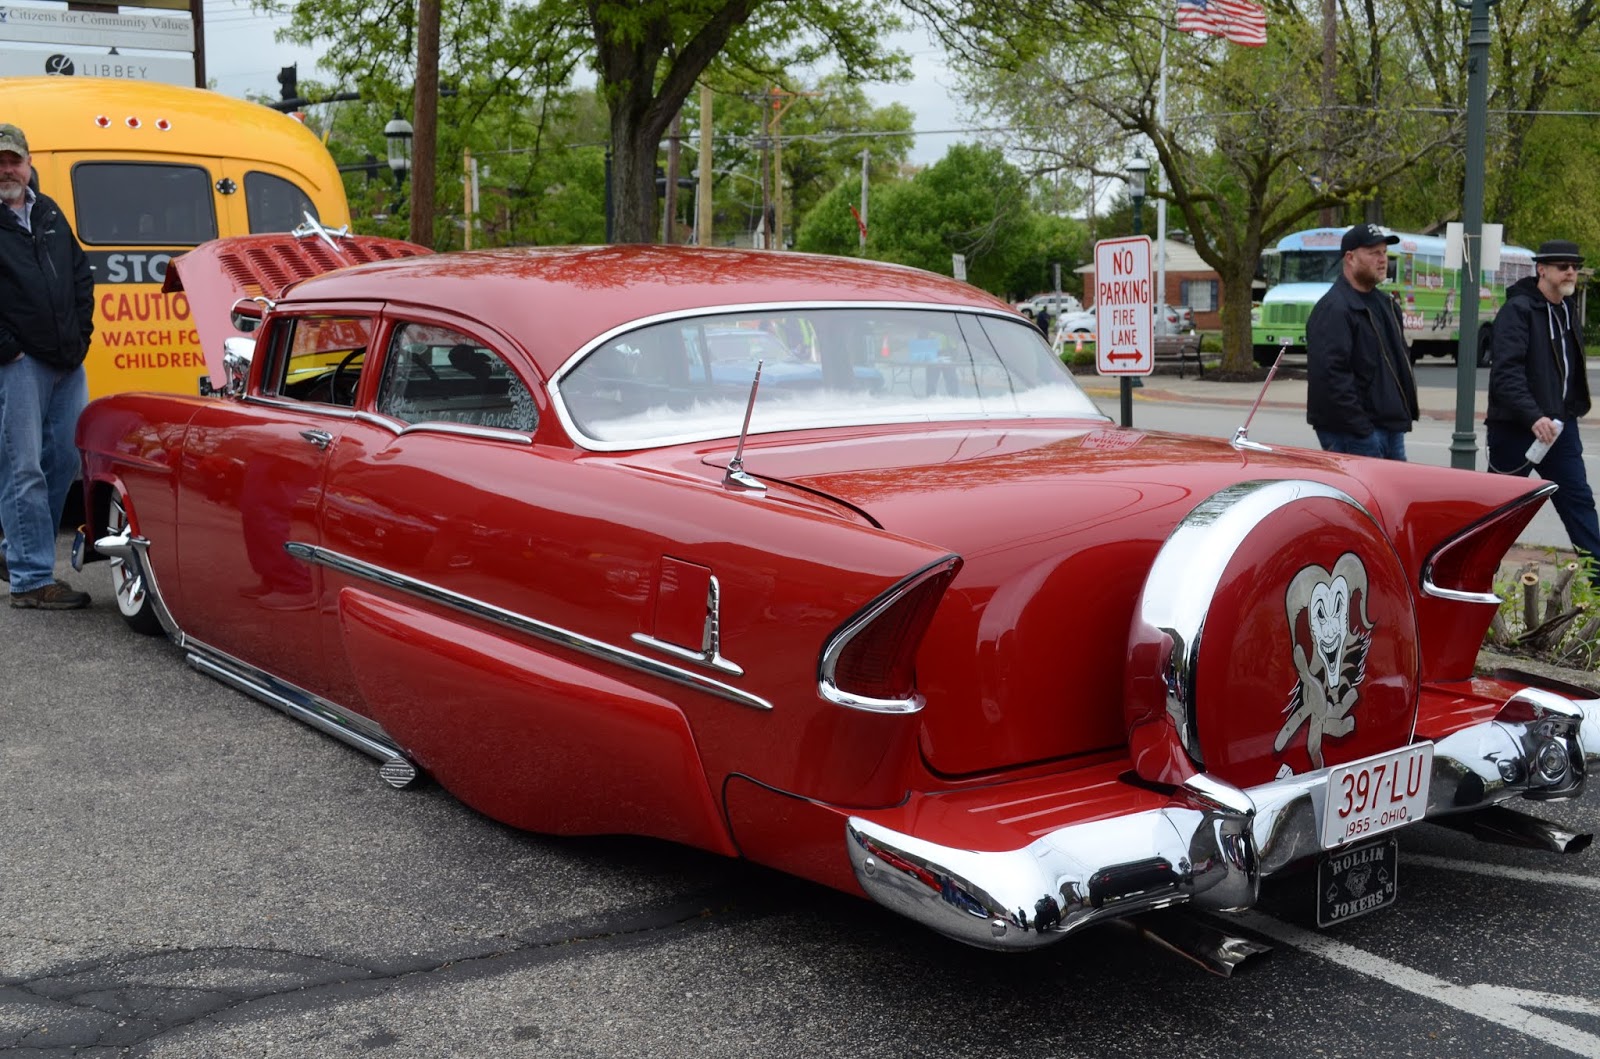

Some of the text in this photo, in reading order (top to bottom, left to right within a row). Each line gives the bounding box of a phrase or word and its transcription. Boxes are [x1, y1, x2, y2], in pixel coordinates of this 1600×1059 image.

[10, 9, 57, 22] Citizens
[61, 13, 77, 24] for
[80, 14, 147, 29] Community
[152, 17, 190, 30] Values
[83, 64, 147, 78] LIBBEY
[106, 254, 172, 283] STO
[1113, 250, 1134, 275] NO
[1100, 279, 1148, 306] PARKING
[101, 293, 191, 322] CAUTIO
[1113, 309, 1135, 326] FIRE
[102, 330, 201, 347] WATCH FO
[1111, 329, 1137, 346] LANE
[114, 352, 206, 369] CHILDREN
[1345, 816, 1370, 838] 1955
[1380, 806, 1407, 826] OHIO
[1332, 847, 1385, 876] ROLLIN
[1331, 890, 1384, 919] JOKERS
